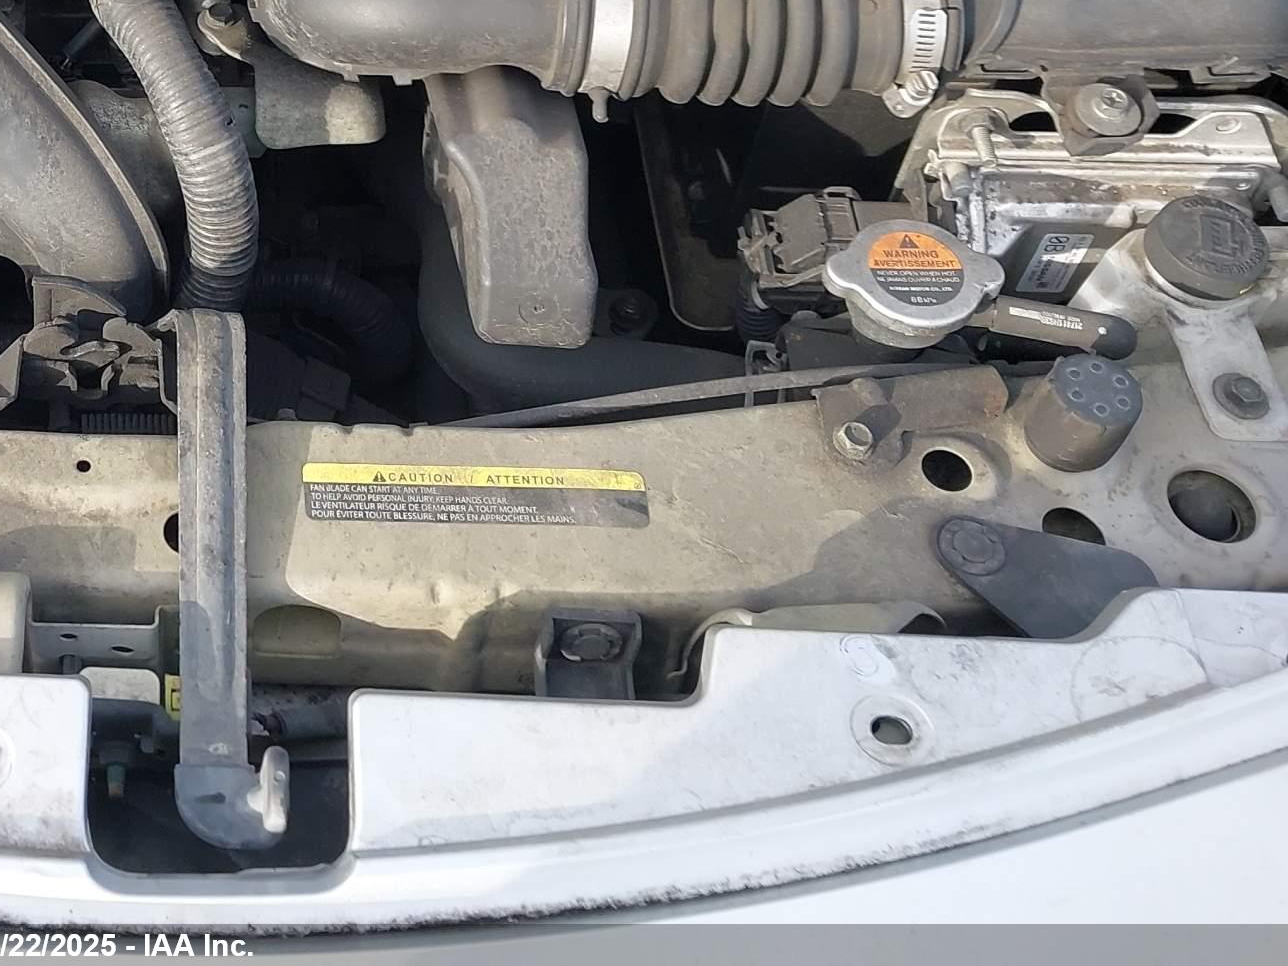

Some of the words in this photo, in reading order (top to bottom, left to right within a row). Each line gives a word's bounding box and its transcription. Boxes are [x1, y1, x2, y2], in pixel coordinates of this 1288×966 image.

[882, 249, 939, 259] WARNING
[873, 259, 956, 268] AVERTISSEMENT
[388, 472, 453, 483] CAUTION
[486, 474, 565, 485] ATTENTION
[310, 484, 325, 492] FAN
[326, 484, 351, 493] BLADE
[351, 485, 368, 493] CAN
[369, 485, 391, 494] START
[392, 486, 402, 494] AT
[403, 486, 418, 494] ANY
[311, 492, 322, 501] TO
[323, 493, 342, 501] HELP
[343, 493, 366, 502] AVOID
[367, 494, 405, 503] PERSONAL
[436, 495, 453, 504] KEEP
[455, 496, 481, 505] HANDS
[311, 500, 322, 509] LE
[321, 501, 376, 510] VENTILATEUR
[377, 502, 407, 511] RISQUE
[408, 503, 420, 512] DE
[475, 505, 497, 513] TOUT
[311, 510, 335, 519] POUR
[336, 509, 365, 519] ÉVITER
[365, 511, 392, 520] TOUTE
[437, 513, 449, 521] NE
[450, 514, 465, 522] PAS
[466, 514, 479, 522] EN
[480, 514, 531, 523] APPROCHER
[531, 515, 546, 523] LES
